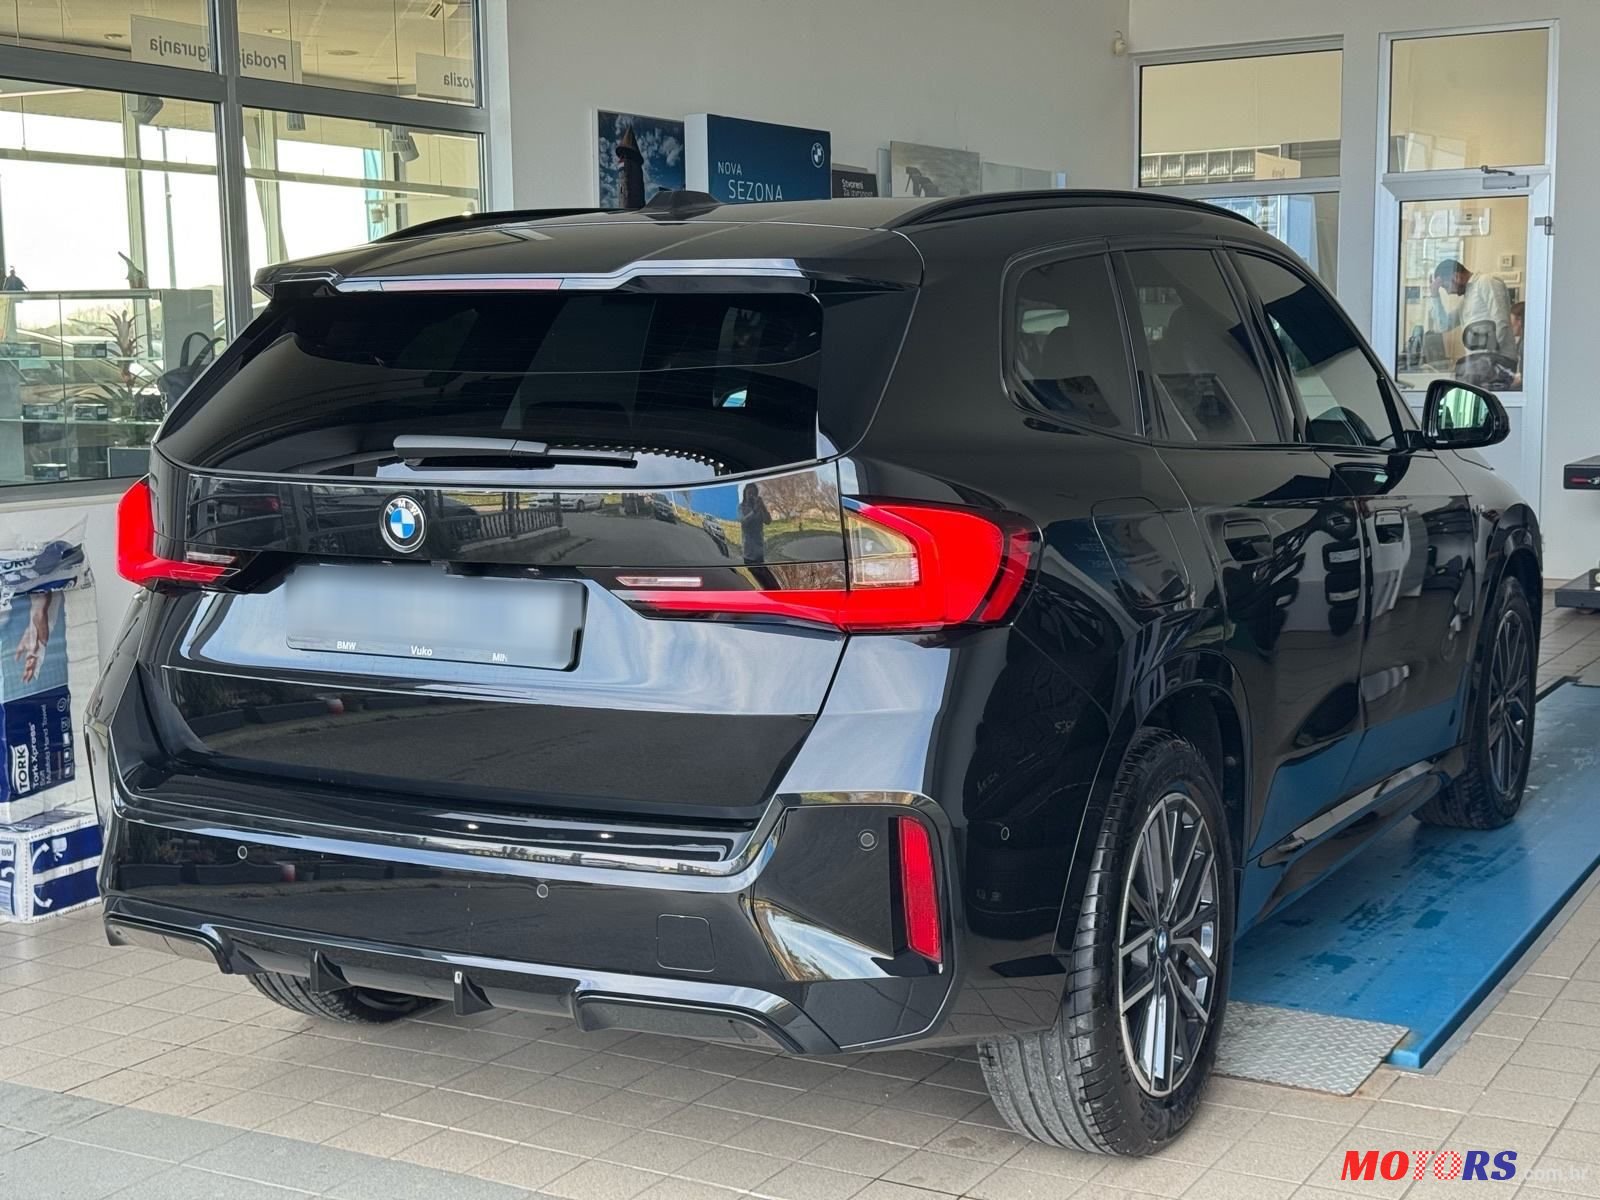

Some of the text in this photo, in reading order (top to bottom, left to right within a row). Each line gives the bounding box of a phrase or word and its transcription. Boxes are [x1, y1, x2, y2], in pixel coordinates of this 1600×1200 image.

[717, 160, 743, 176] NOVA
[727, 179, 784, 202] SEZONA
[386, 497, 421, 516] BMW
[336, 640, 357, 651] BMW
[410, 645, 434, 657] Vuko
[17, 748, 29, 791] TORK
[32, 763, 40, 790] Tork
